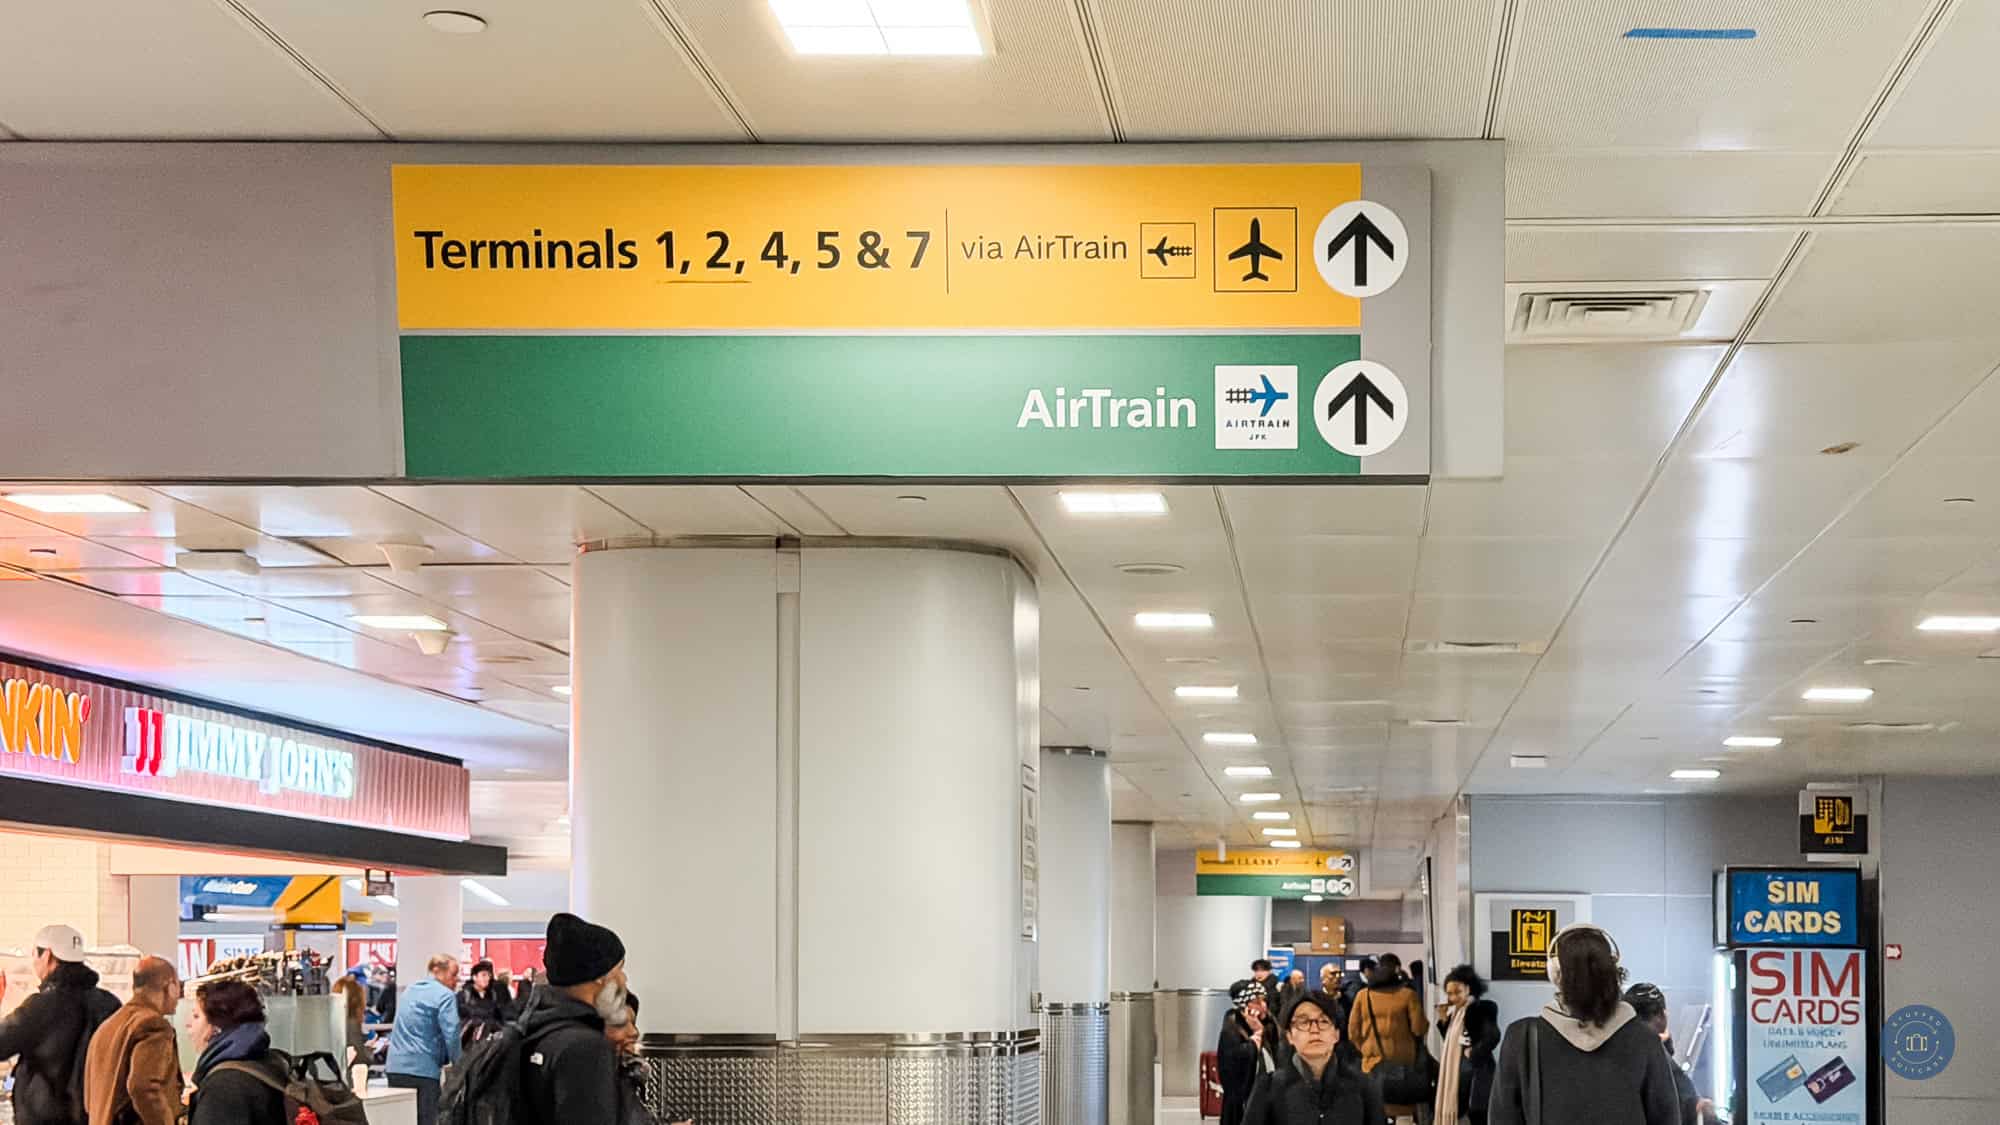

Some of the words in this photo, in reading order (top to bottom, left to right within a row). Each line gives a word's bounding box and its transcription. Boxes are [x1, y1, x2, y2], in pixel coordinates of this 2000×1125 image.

[413, 228, 639, 270] Terminals
[655, 230, 691, 275] 1,
[705, 230, 746, 275] 2,
[760, 230, 801, 275] 4,
[816, 230, 841, 270] 5
[856, 230, 891, 270] &
[906, 230, 931, 269] 7
[961, 235, 1004, 260] via
[1014, 234, 1128, 260] AirTrain
[1016, 386, 1197, 429] AirTrain
[1225, 419, 1291, 429] AIRTRAIN
[1248, 433, 1268, 441] JFK
[162, 713, 267, 781] JIMMY
[260, 736, 354, 799] JOHN'S
[1768, 881, 1820, 904] SIM
[1744, 910, 1842, 934] CARDS
[1750, 951, 1861, 997] SIM
[1751, 998, 1860, 1025] CARDS
